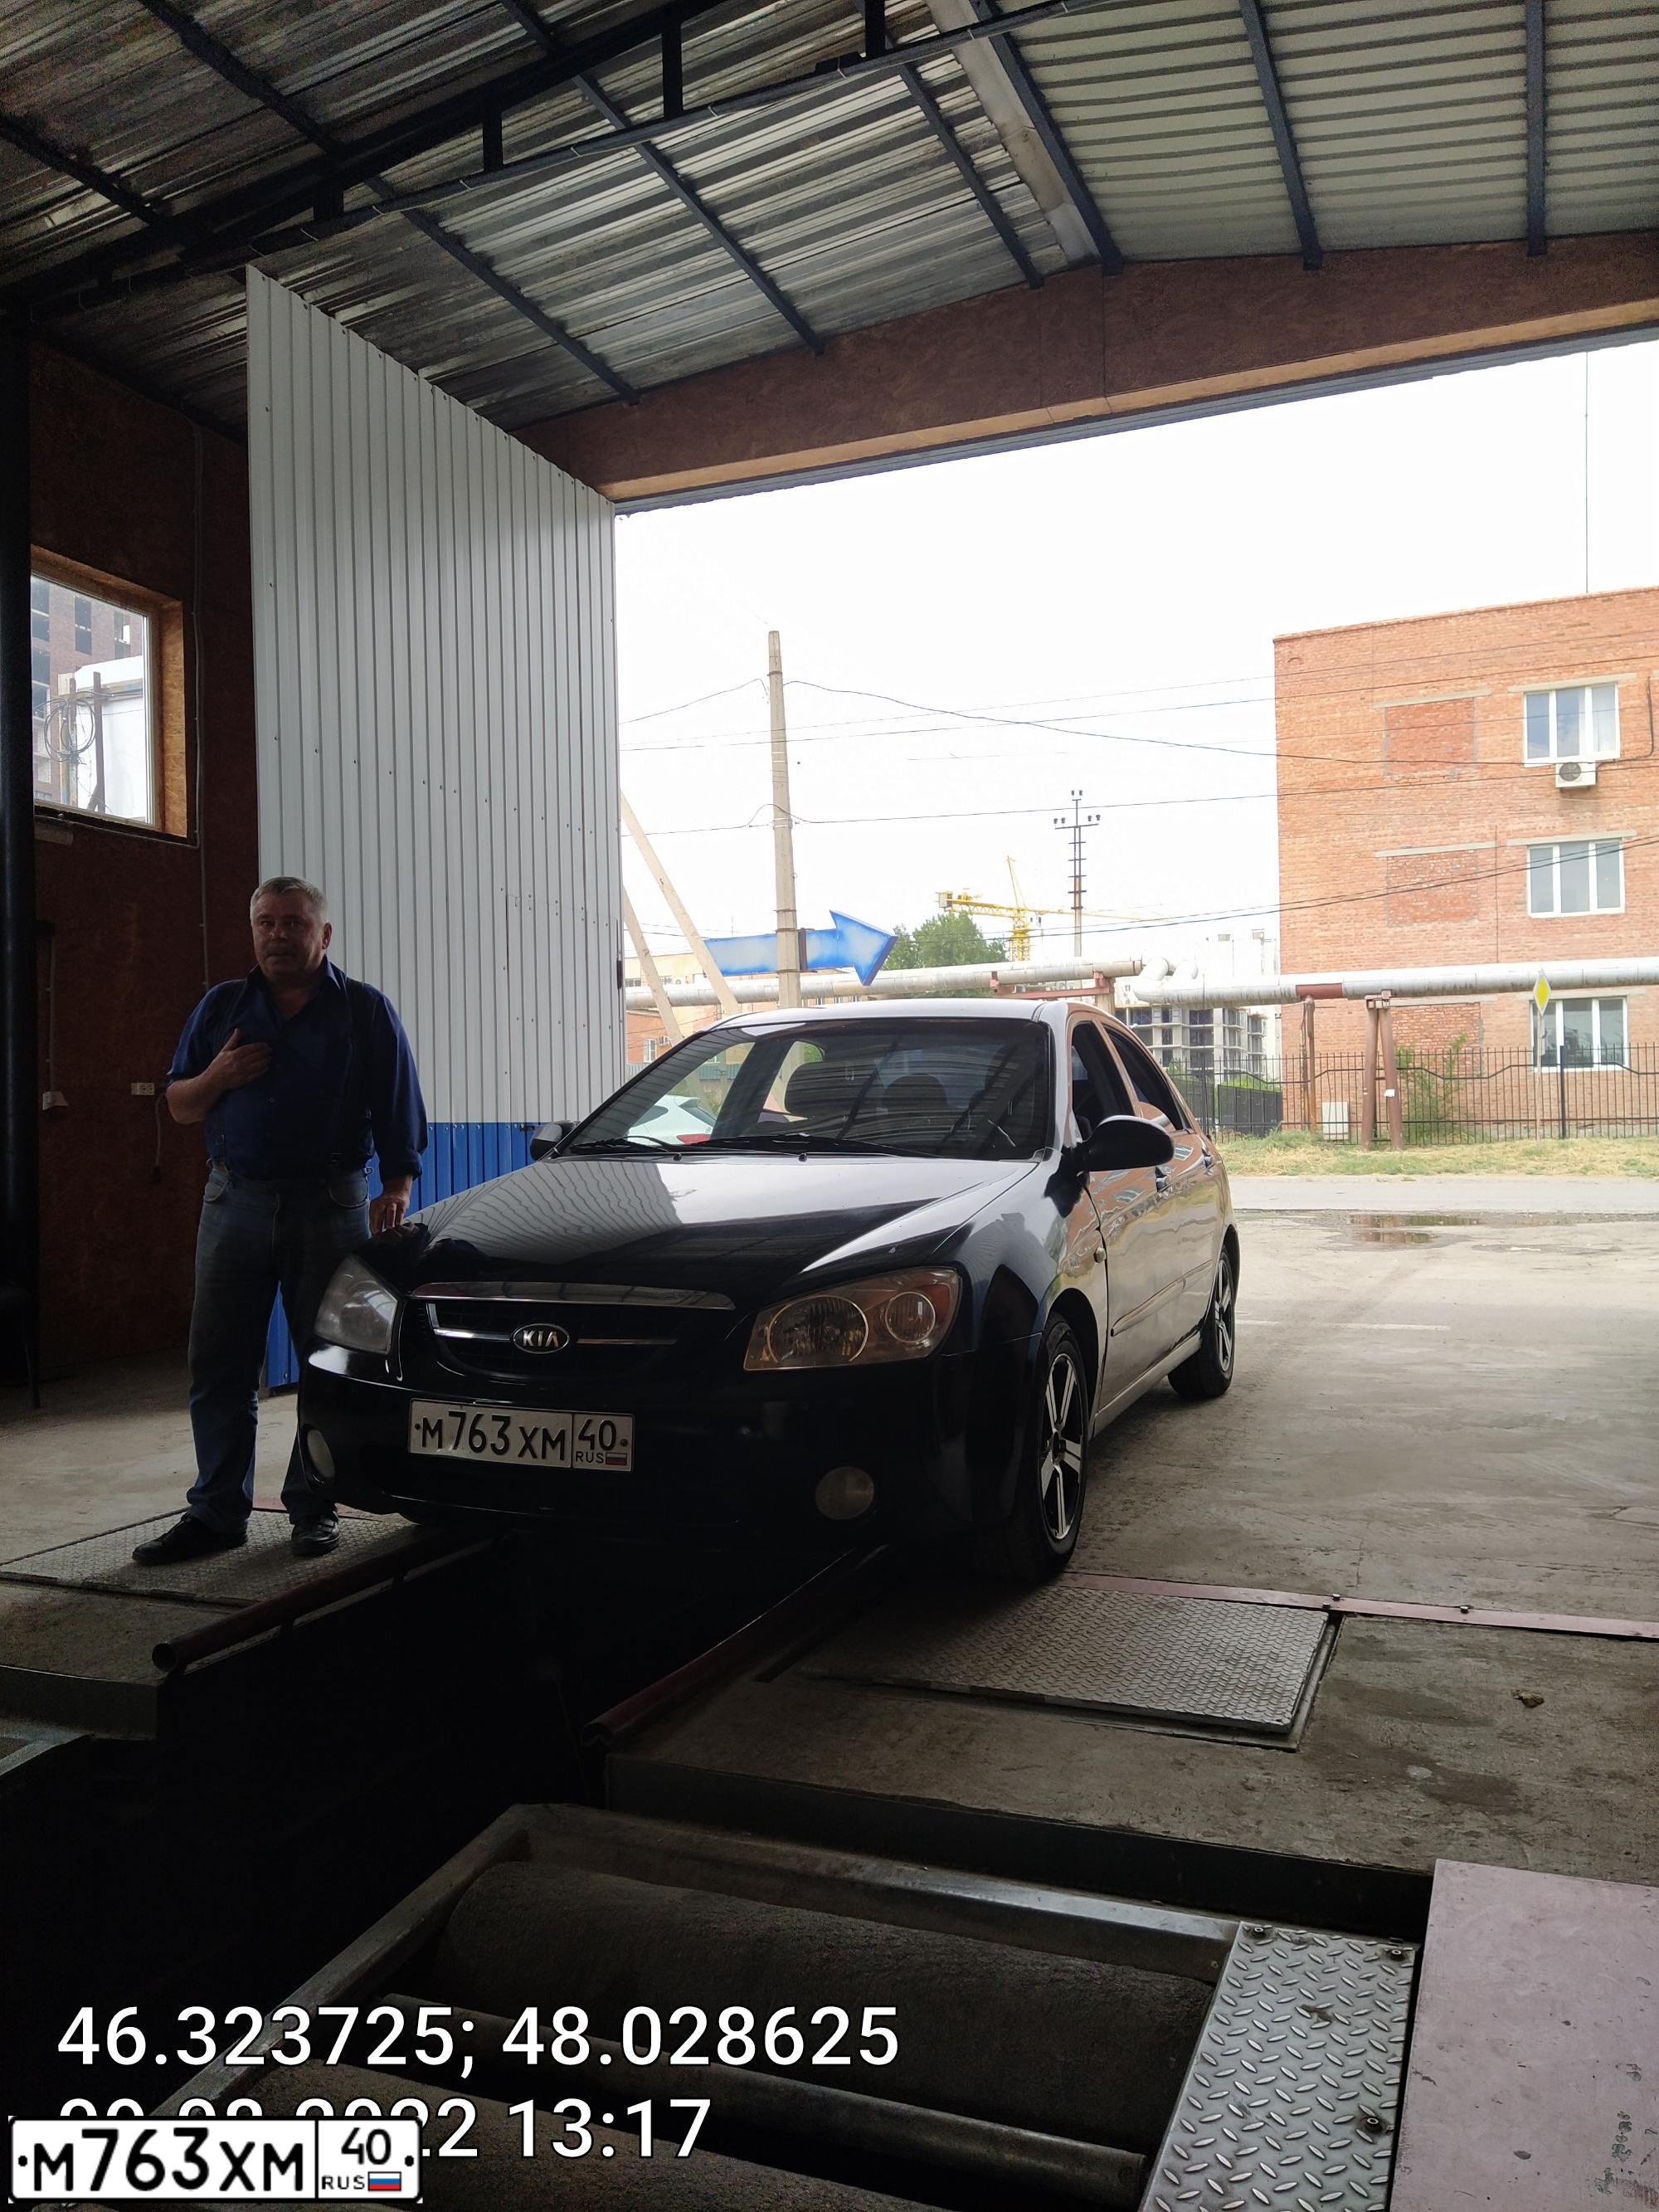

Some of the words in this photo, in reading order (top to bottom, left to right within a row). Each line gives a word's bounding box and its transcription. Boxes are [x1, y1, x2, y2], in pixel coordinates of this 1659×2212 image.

[523, 1330, 559, 1347] KIA
[421, 1411, 566, 1461] М763ХМ
[577, 1419, 617, 1451] 40
[576, 1450, 604, 1464] RUS
